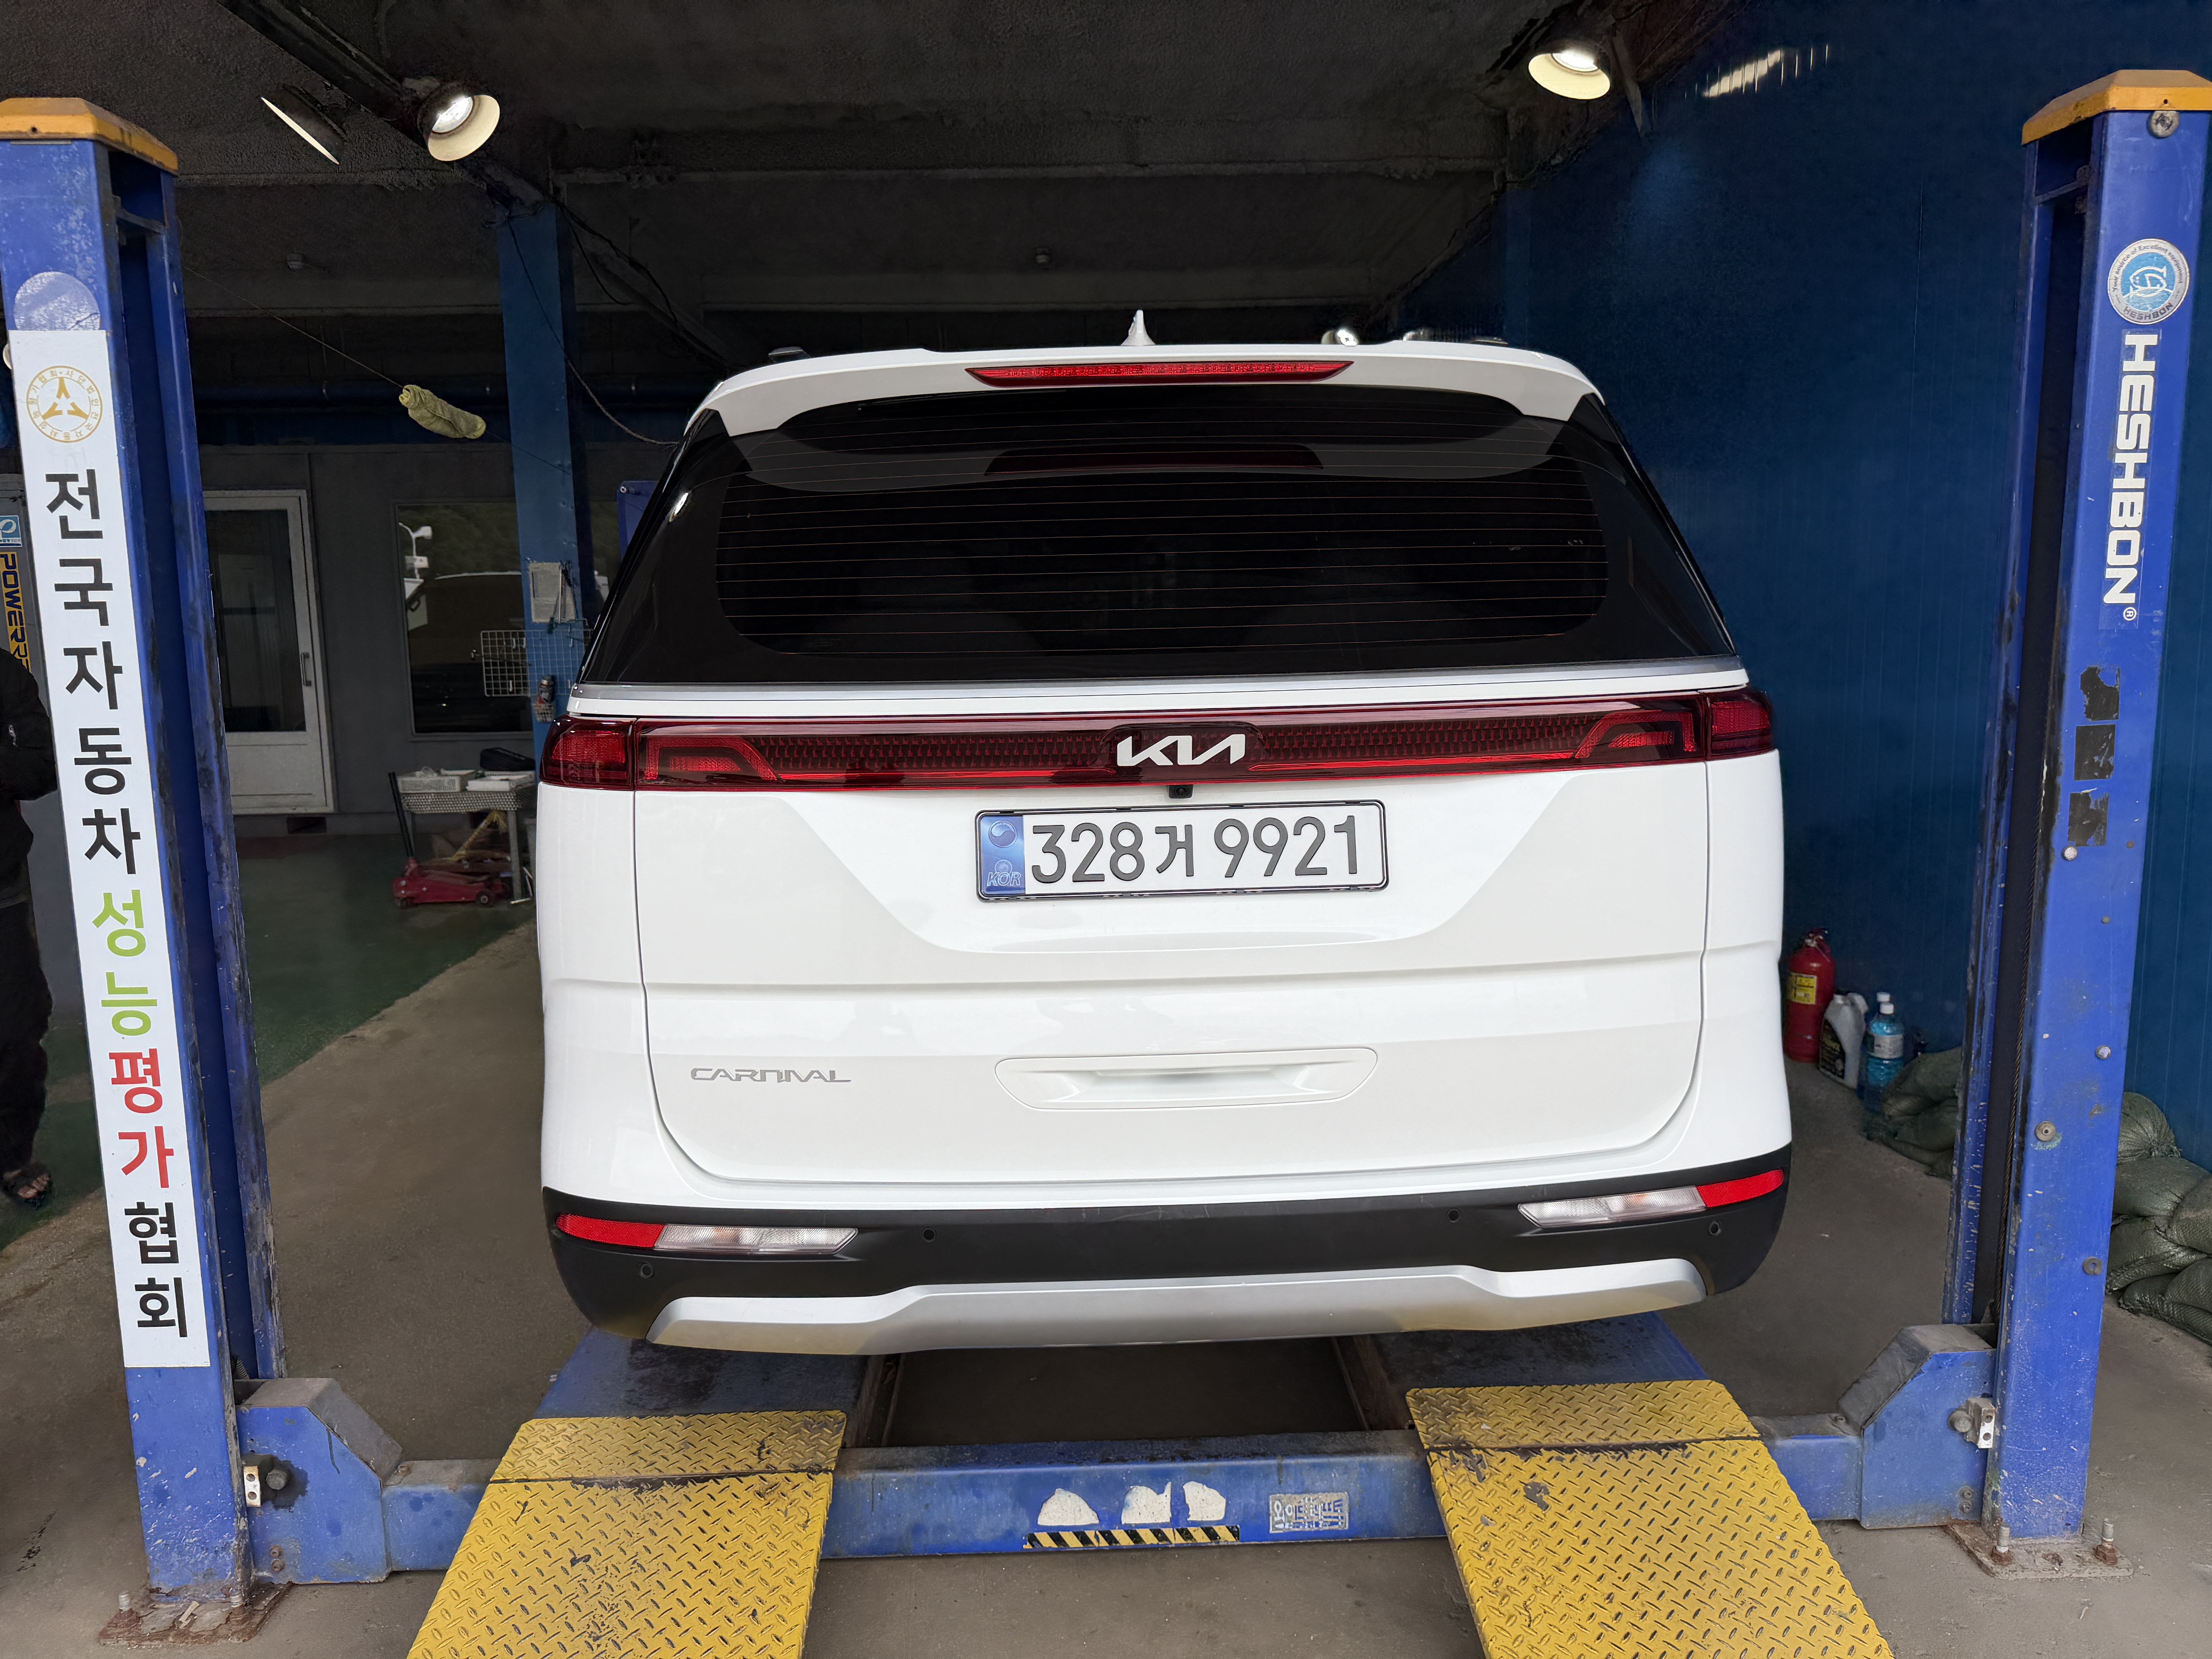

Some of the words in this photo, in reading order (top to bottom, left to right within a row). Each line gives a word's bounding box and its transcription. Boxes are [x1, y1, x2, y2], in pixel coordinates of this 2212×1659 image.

[2117, 254, 2130, 275] source
[2123, 302, 2174, 320] HESHBON
[0, 554, 29, 673] POWERR
[1117, 733, 1246, 767] KIA
[1213, 814, 1356, 879] 9921
[987, 871, 1021, 886] KOR
[691, 1067, 852, 1083] CARNIVAL
